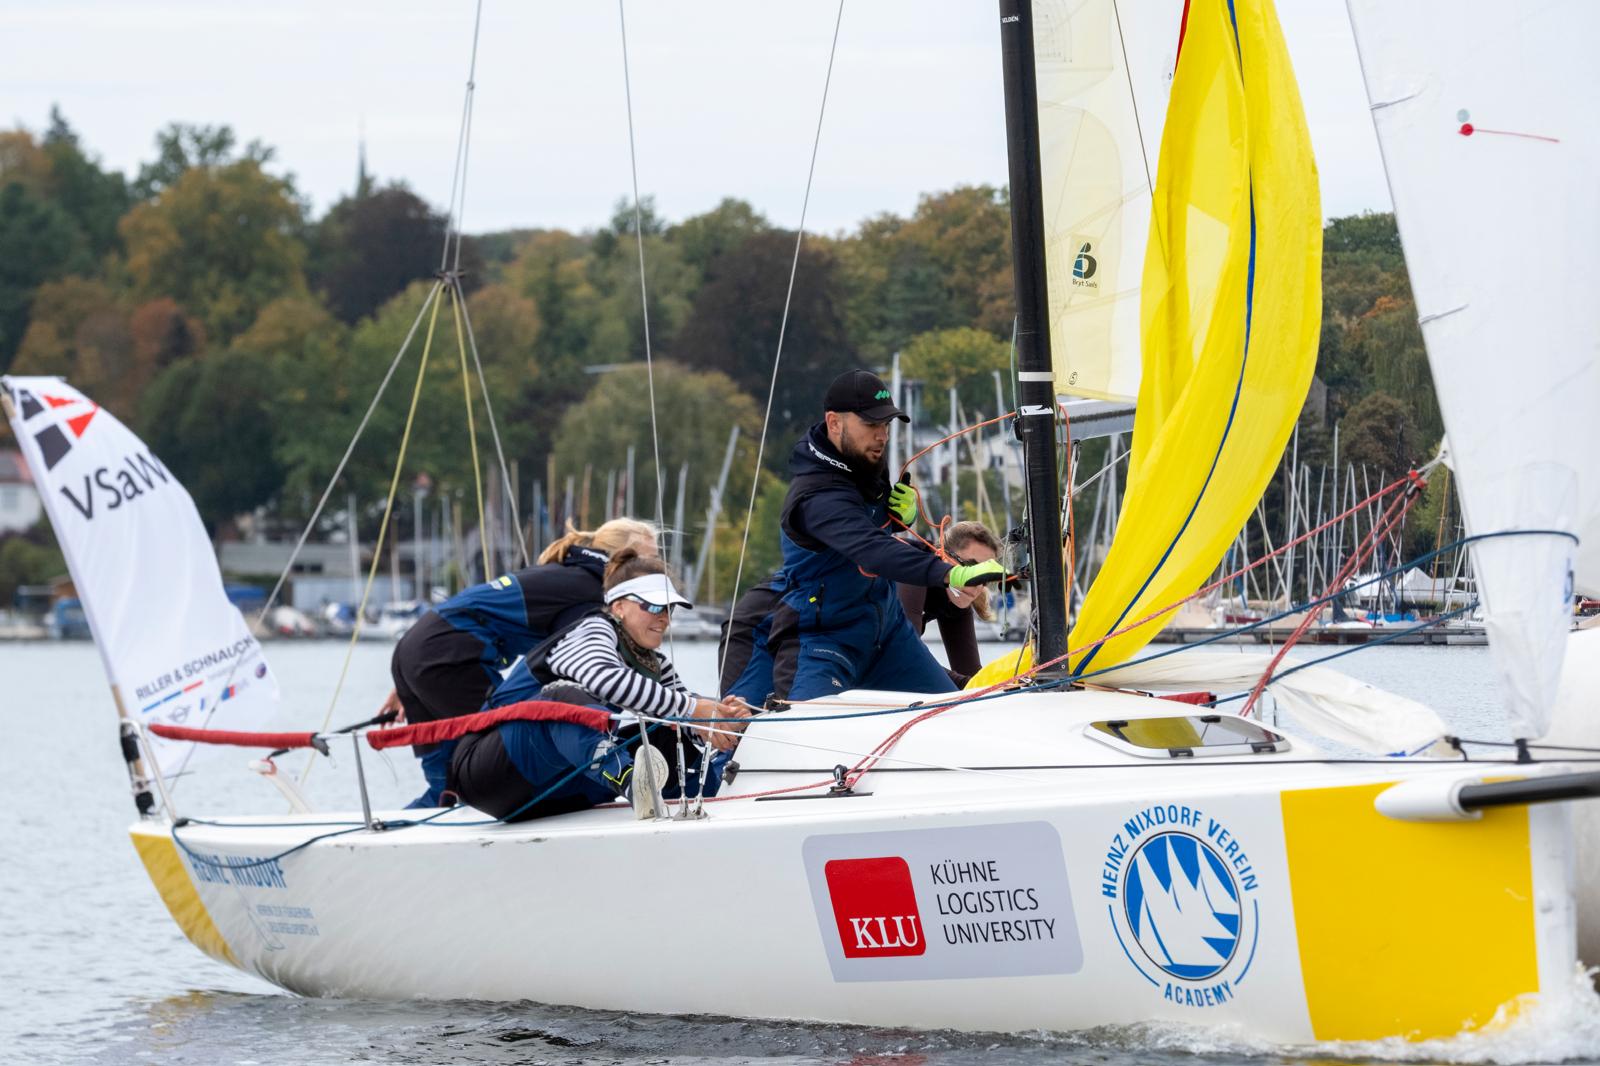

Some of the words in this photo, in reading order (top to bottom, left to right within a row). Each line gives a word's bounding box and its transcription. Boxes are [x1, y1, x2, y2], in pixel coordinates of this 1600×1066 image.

[60, 452, 170, 521] VSaW
[136, 673, 173, 700] RILLER
[174, 668, 183, 682] &
[1102, 833, 1130, 899] HEINZ
[1124, 805, 1203, 840] NIXDORF
[1207, 818, 1259, 892] VEREIN
[930, 859, 1000, 885] KÜHNE
[936, 888, 1039, 915] LOGISTICS
[849, 915, 919, 949] KLU
[943, 918, 1056, 945] UNIVERSITY
[1164, 981, 1234, 1007] ACADEMY
